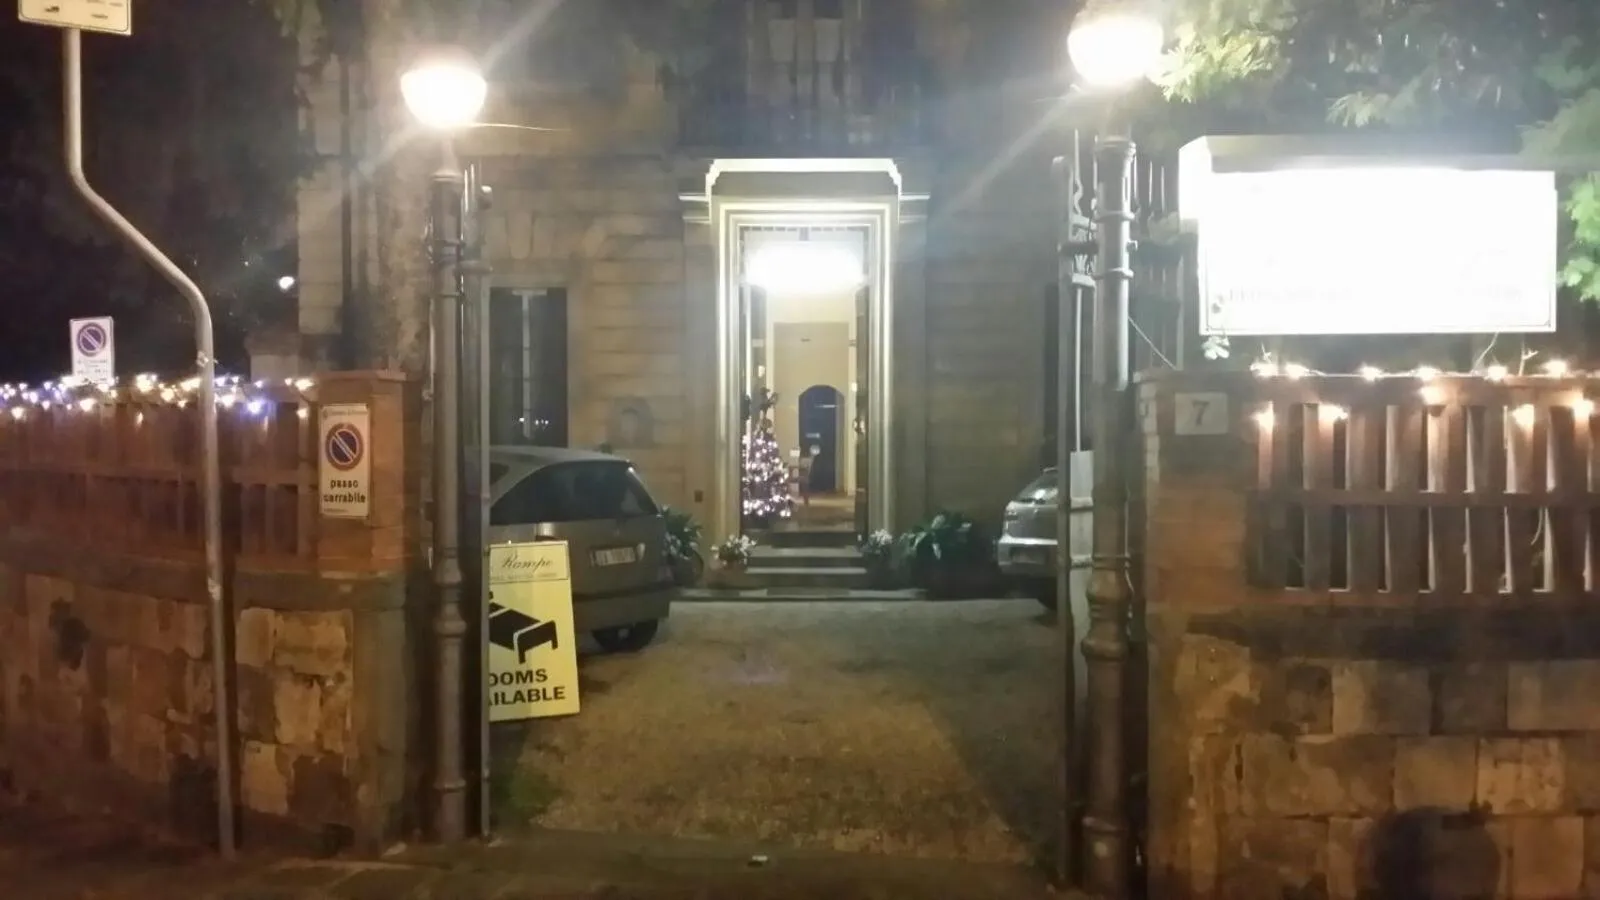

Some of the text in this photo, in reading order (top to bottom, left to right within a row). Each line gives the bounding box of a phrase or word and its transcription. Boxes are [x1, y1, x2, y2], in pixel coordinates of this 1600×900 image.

[1191, 399, 1210, 427] 7
[330, 479, 359, 490] passo
[323, 492, 366, 504] carrabile
